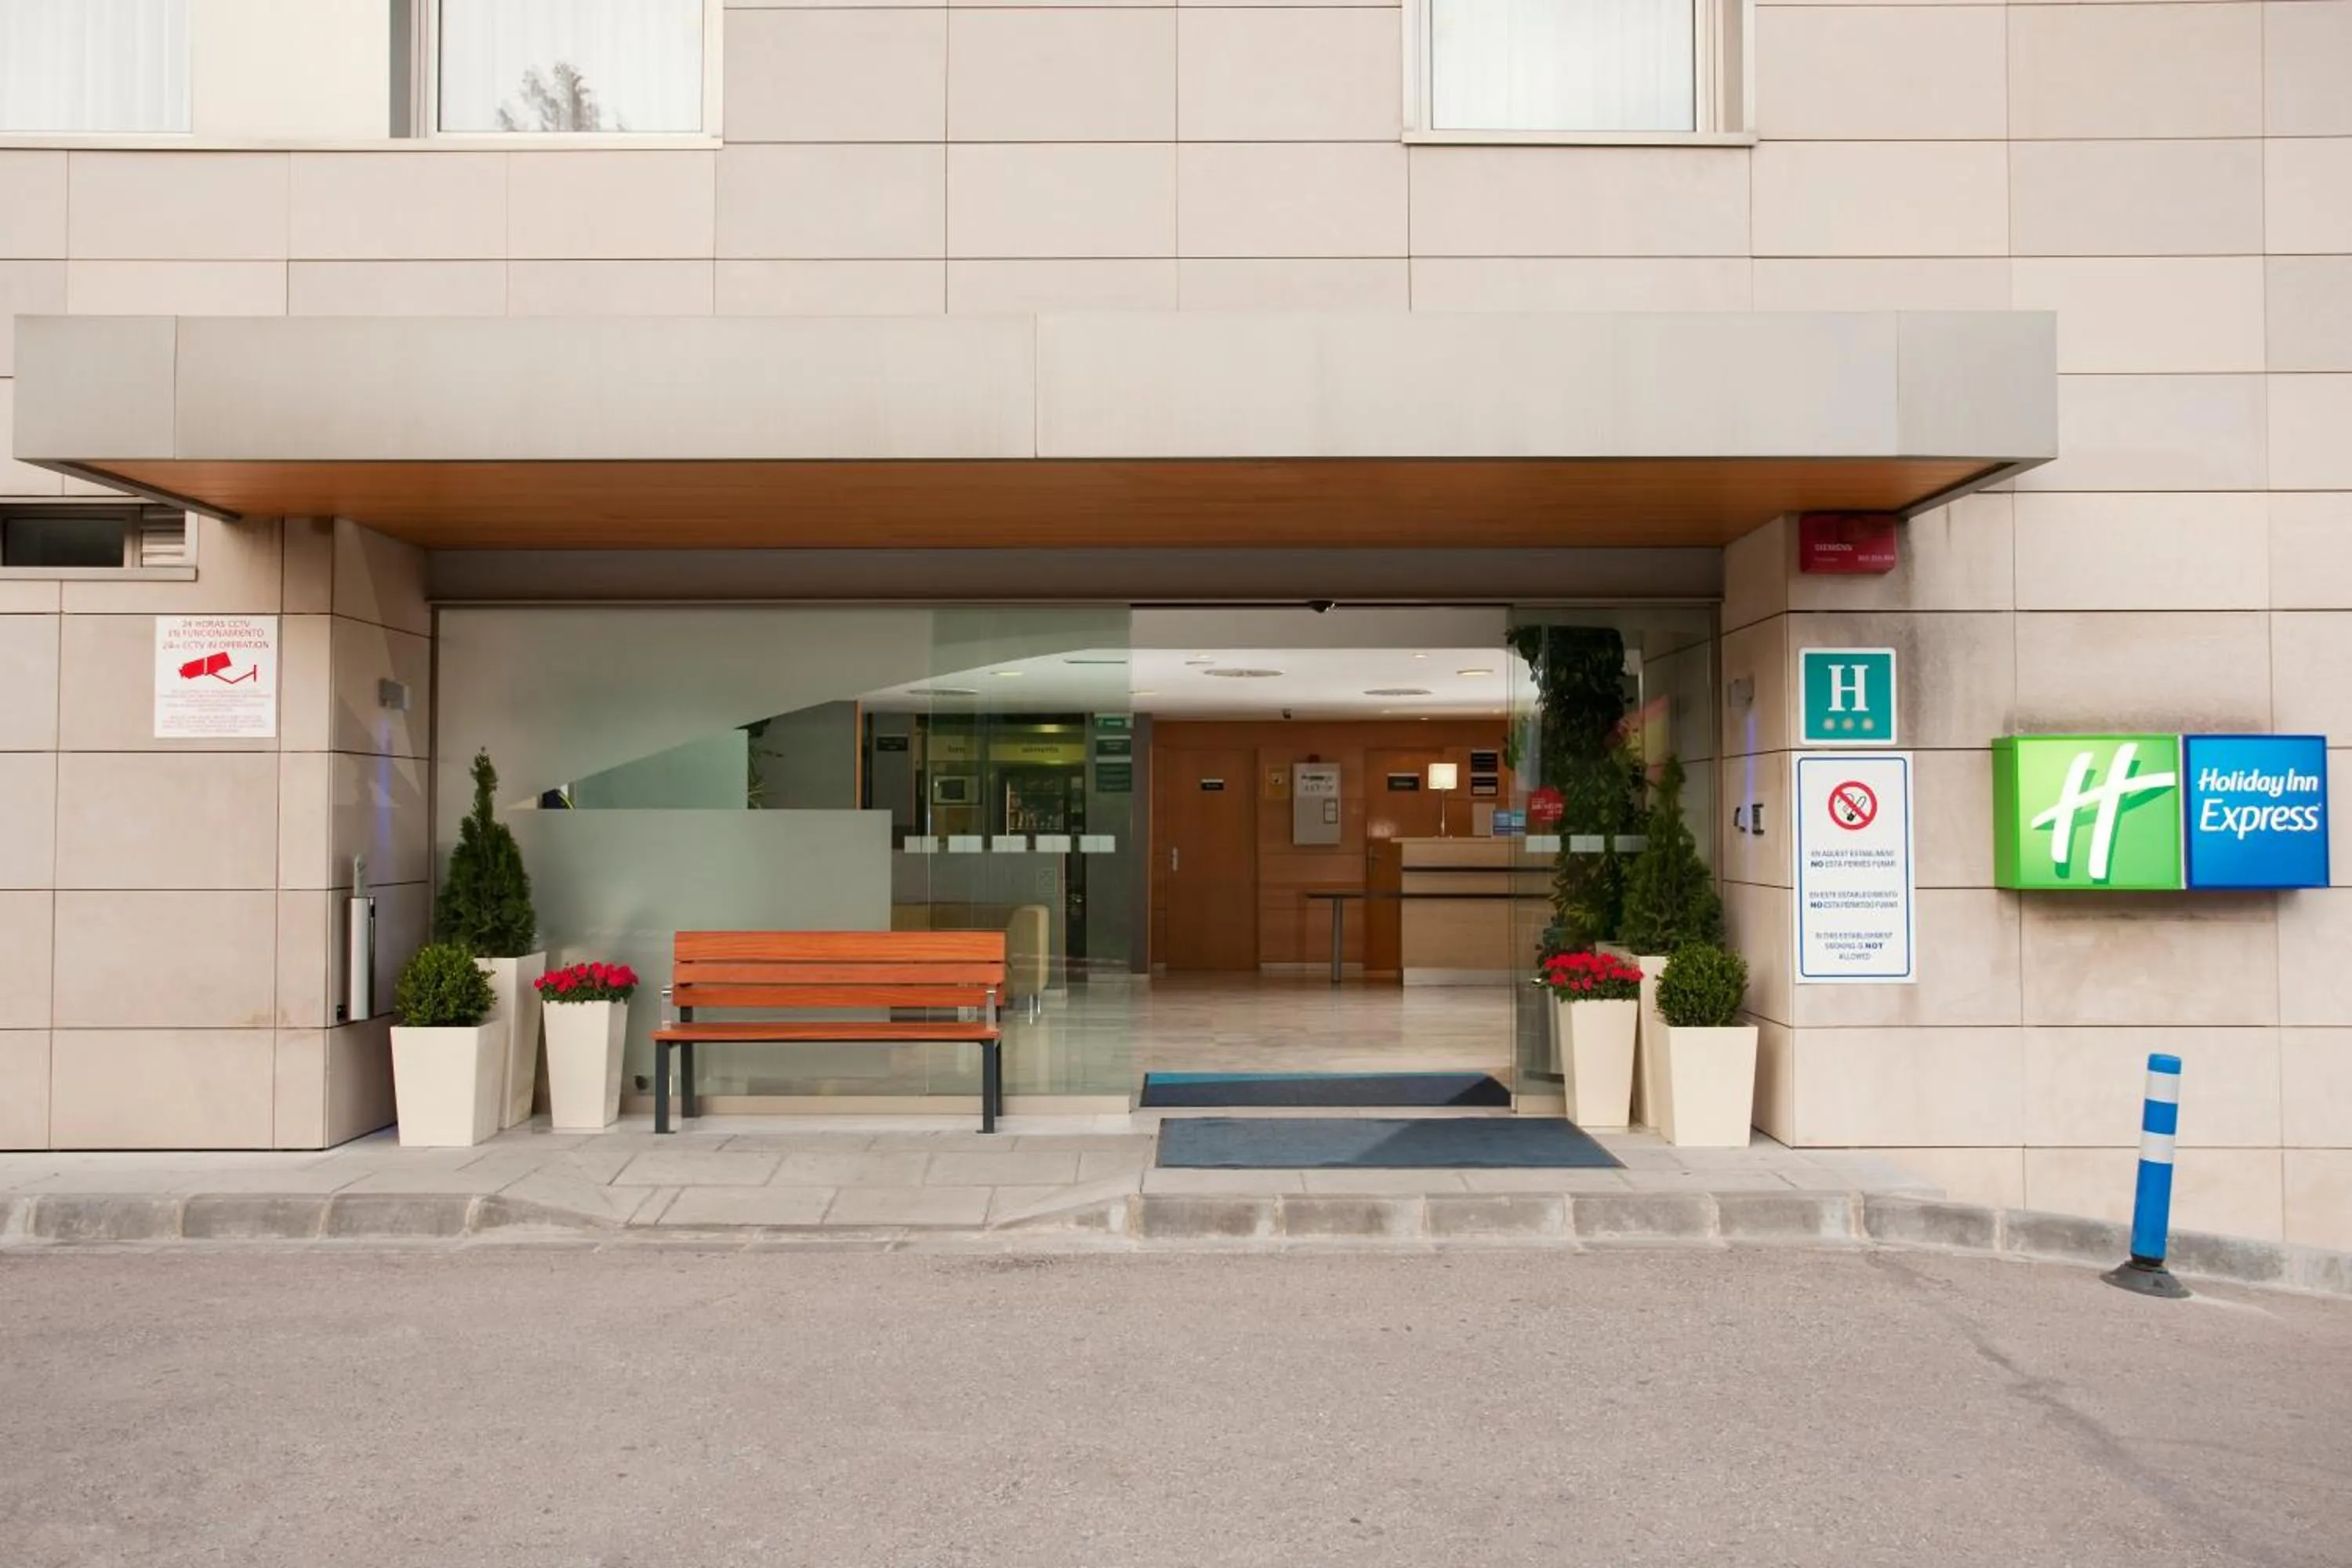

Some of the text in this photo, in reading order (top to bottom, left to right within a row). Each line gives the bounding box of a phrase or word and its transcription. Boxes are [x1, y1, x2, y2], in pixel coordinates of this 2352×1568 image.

[168, 629, 180, 637] EN
[181, 619, 250, 628] 24 HORAS CCTV
[1828, 664, 1869, 712] H
[2198, 768, 2318, 797] Holiday Inn
[2199, 798, 2319, 840] Express
